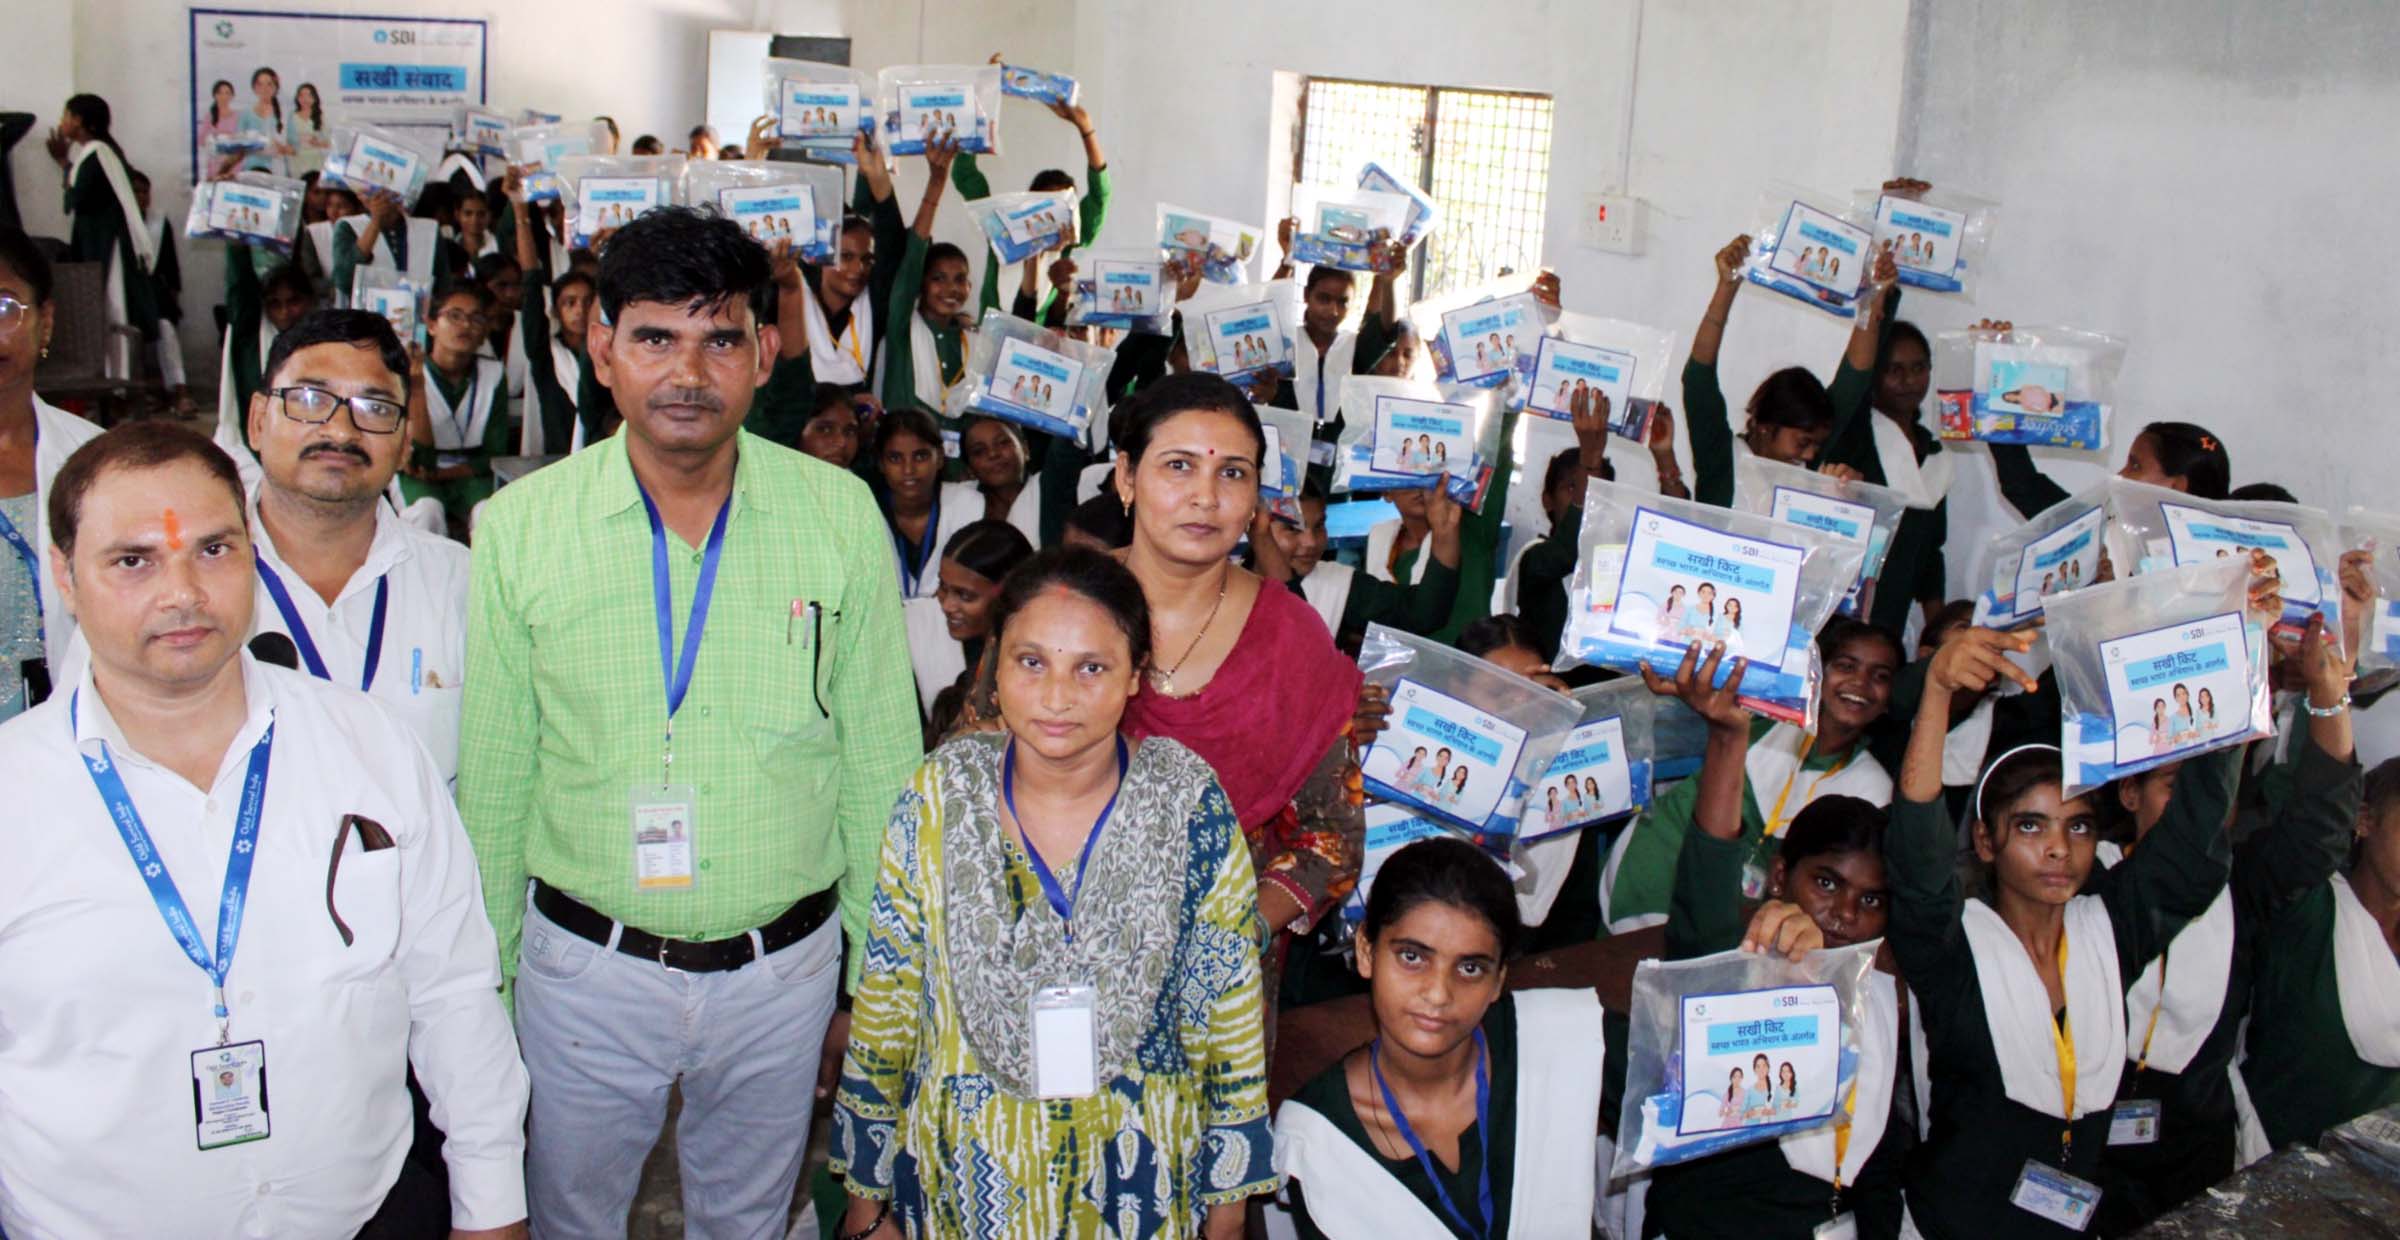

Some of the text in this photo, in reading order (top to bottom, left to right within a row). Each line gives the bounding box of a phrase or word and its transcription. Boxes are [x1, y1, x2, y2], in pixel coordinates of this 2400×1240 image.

[390, 29, 415, 45] SBI
[354, 65, 454, 89] सखी संवाद
[1742, 545, 1759, 557] SBI
[1687, 553, 1714, 569] सखी
[1717, 557, 1741, 575] किट
[2190, 628, 2204, 639] SBI
[2152, 651, 2197, 671] सखी किट
[1434, 716, 1457, 734] सखी
[1457, 726, 1477, 744] किट
[1782, 996, 1798, 1007] SBI
[1737, 1018, 1784, 1036] सखी किट
